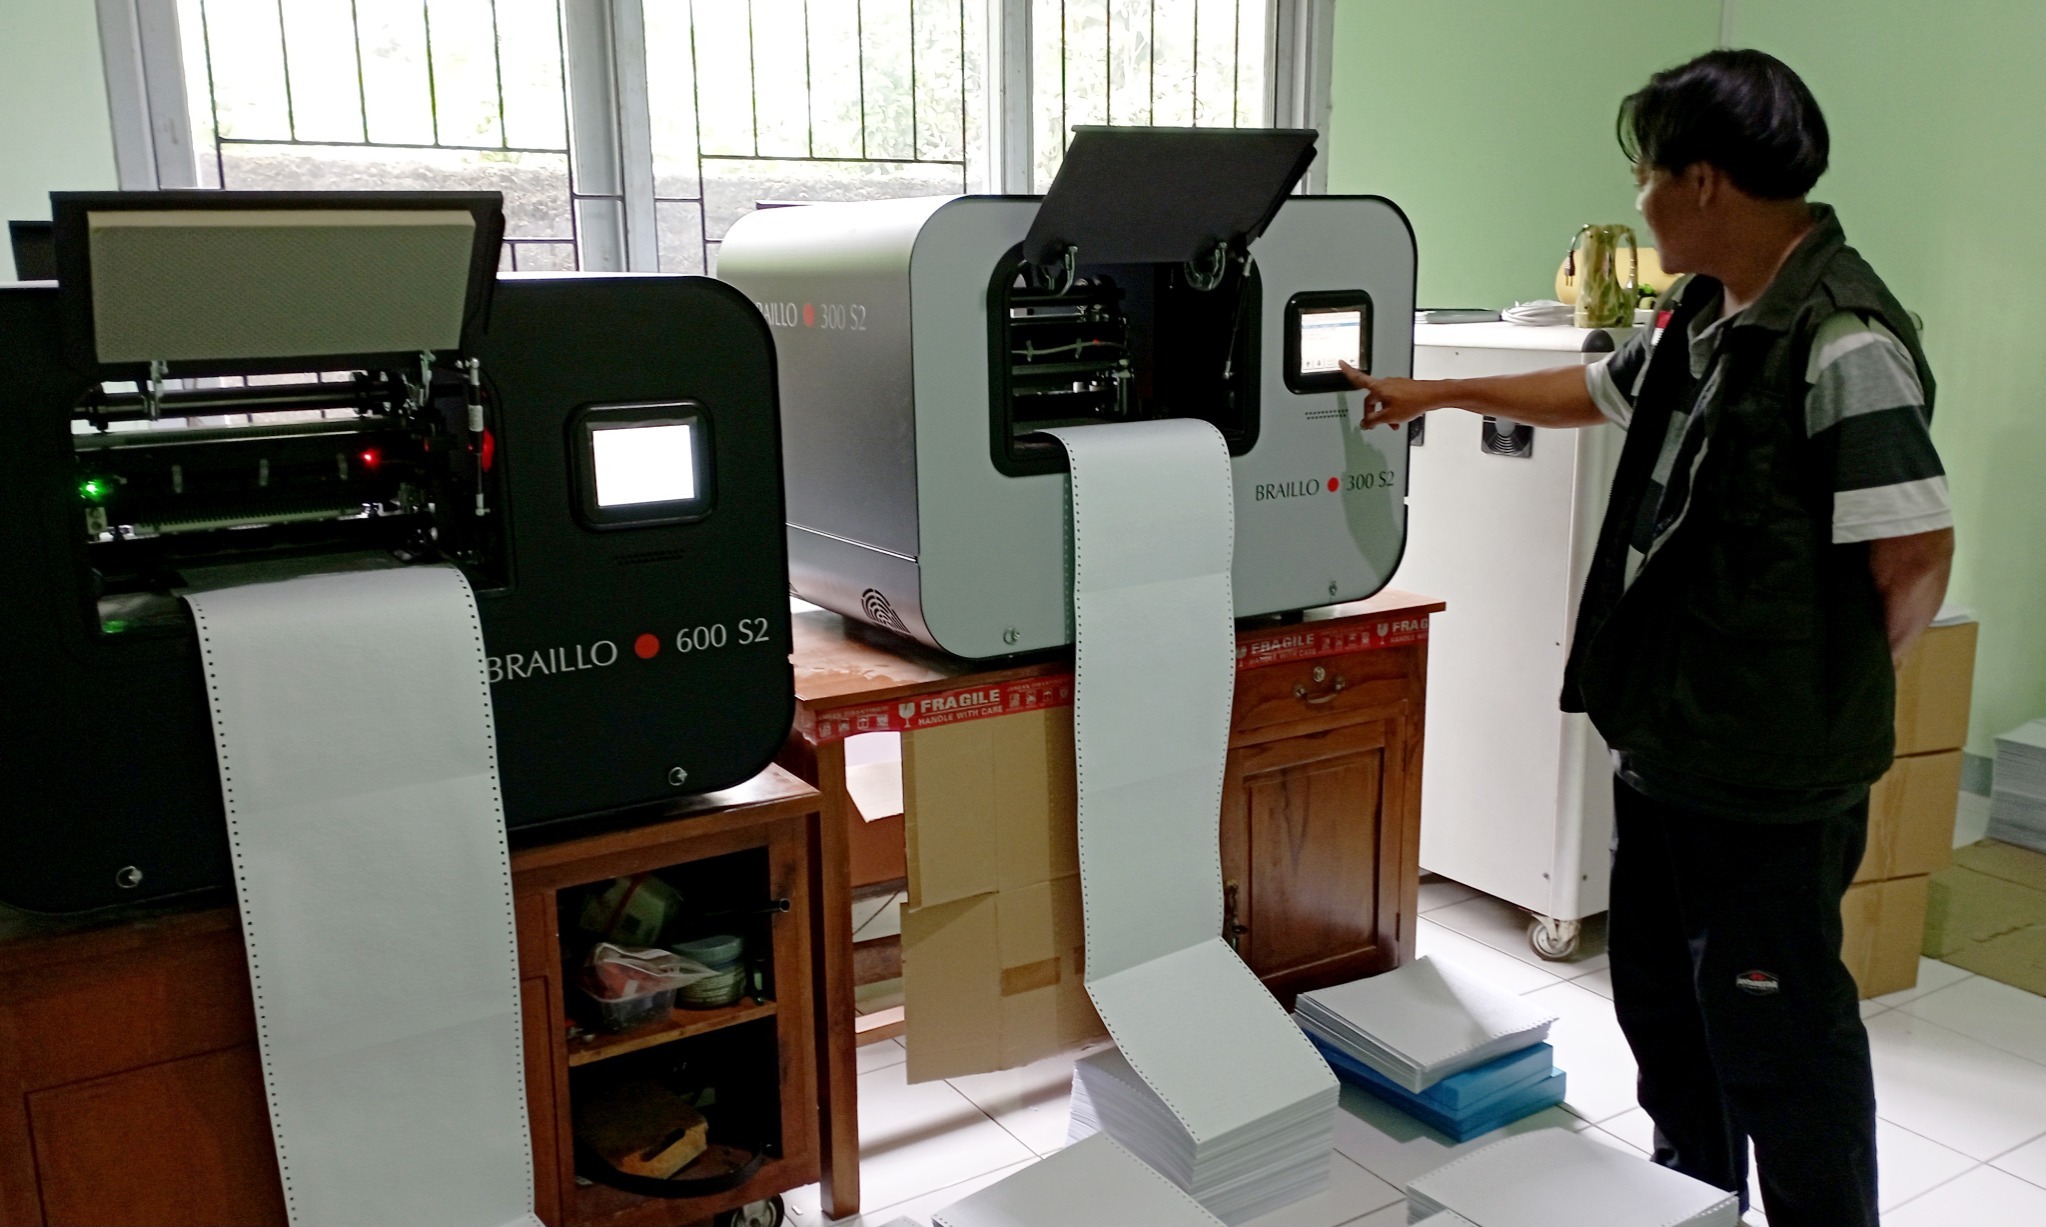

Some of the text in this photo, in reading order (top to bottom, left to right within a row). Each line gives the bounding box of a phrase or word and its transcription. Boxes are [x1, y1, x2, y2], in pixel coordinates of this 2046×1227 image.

[755, 302, 866, 331] RAILLO 300 S2
[1256, 471, 1395, 501] BRAILLO 300 S2
[488, 617, 769, 683] BRAILLO 600 S2
[918, 713, 954, 726] HANDLE
[956, 709, 979, 719] WITH
[981, 705, 1003, 715] CARE
[920, 689, 1000, 713] FRAGILE
